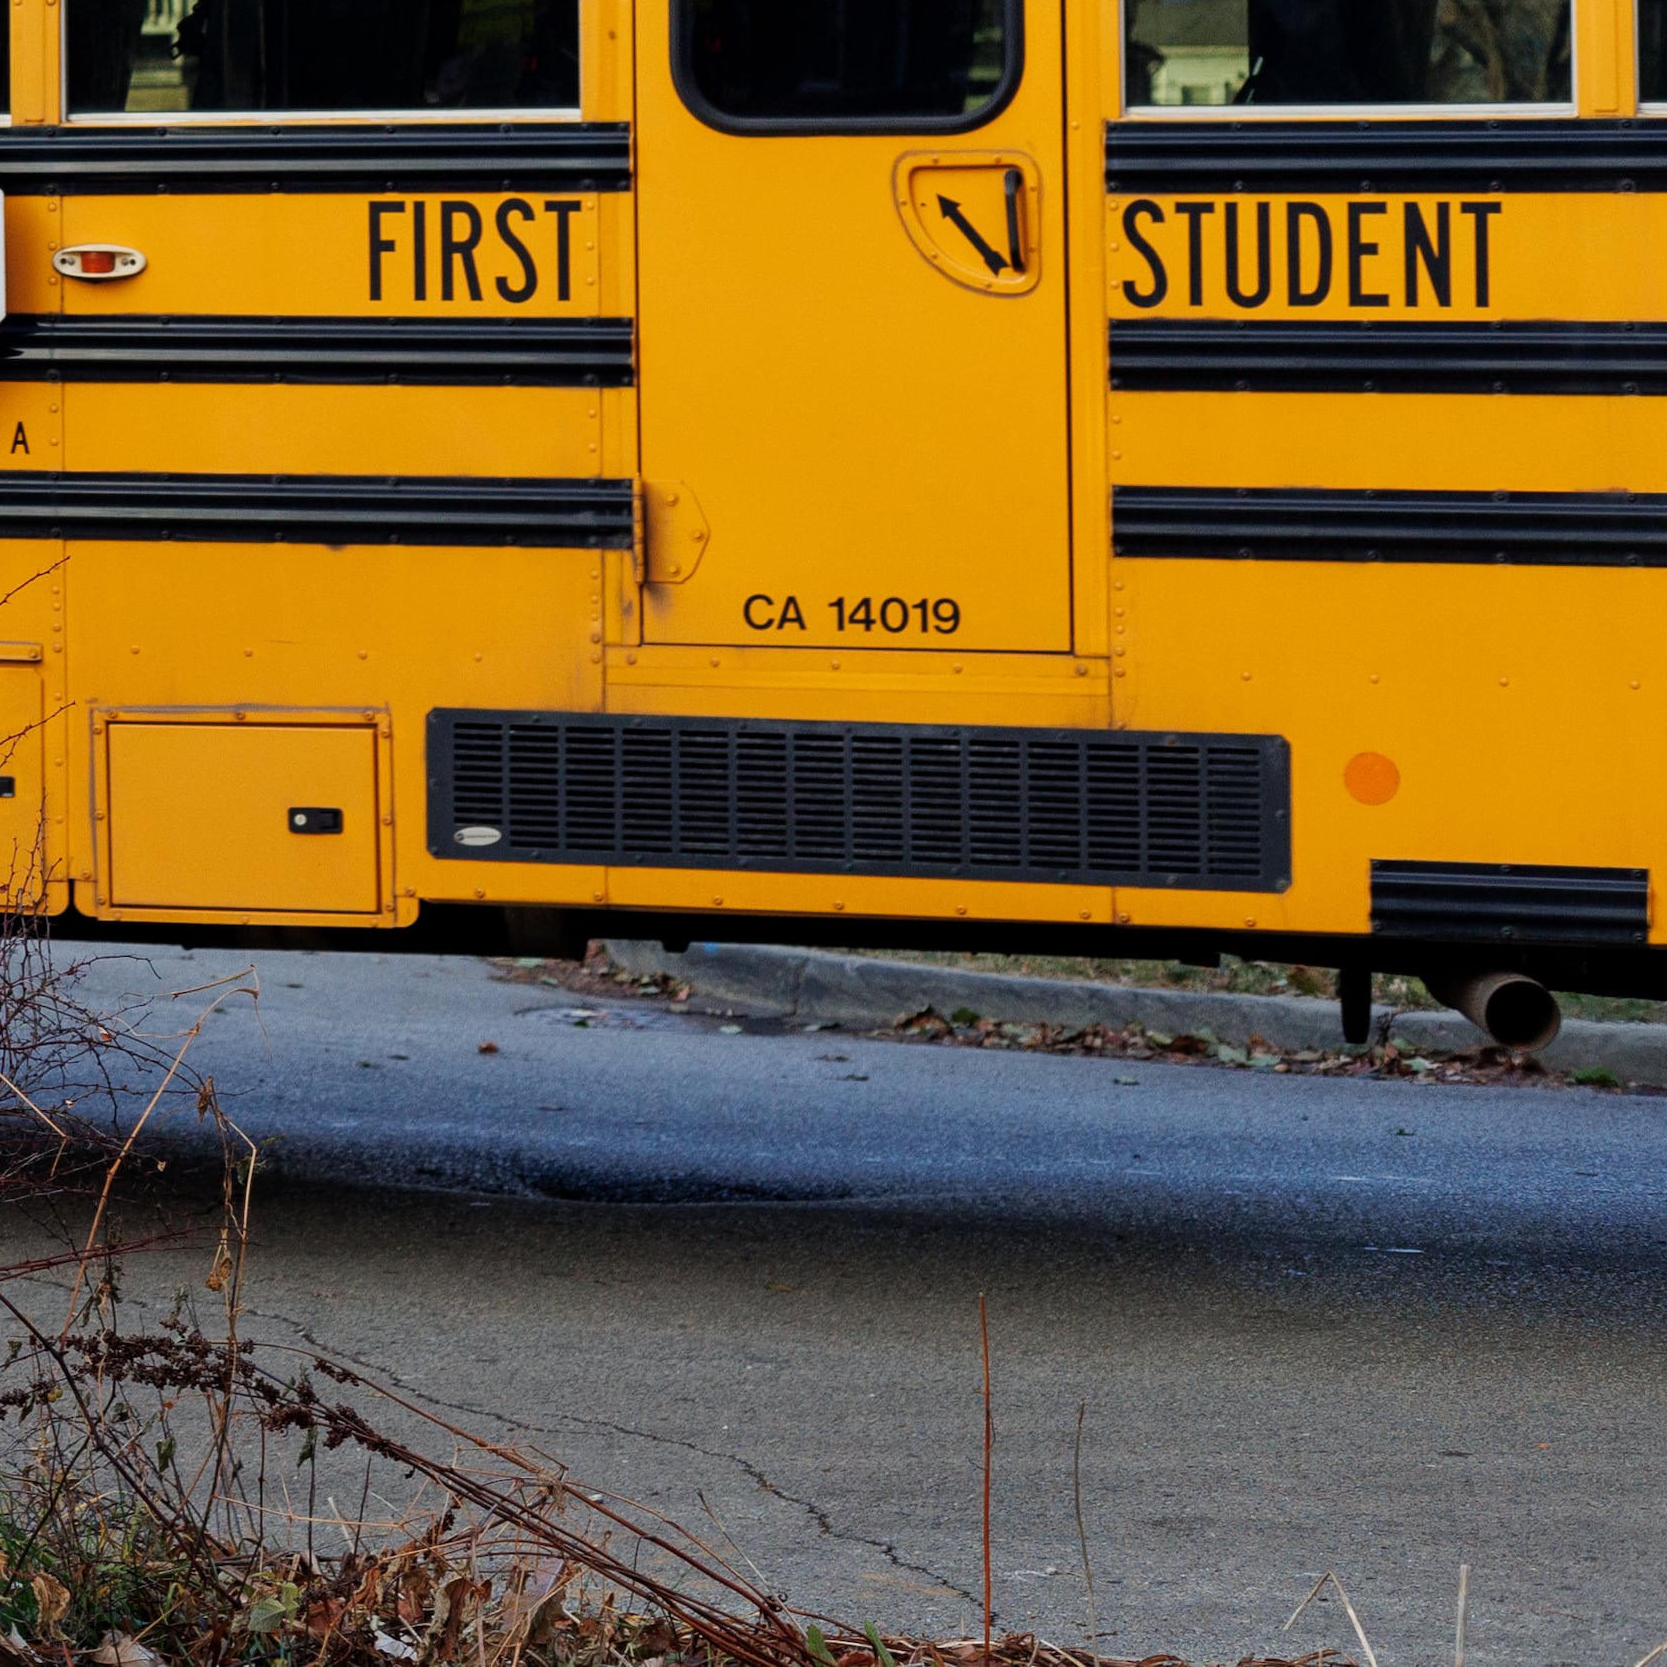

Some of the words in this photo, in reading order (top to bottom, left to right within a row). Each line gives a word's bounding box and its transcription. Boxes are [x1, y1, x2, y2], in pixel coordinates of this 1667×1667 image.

[368, 198, 583, 303] FIRST
[1121, 198, 1503, 309] STUDENT
[10, 421, 31, 455] A
[743, 593, 807, 631] CA
[827, 596, 961, 635] 14019
